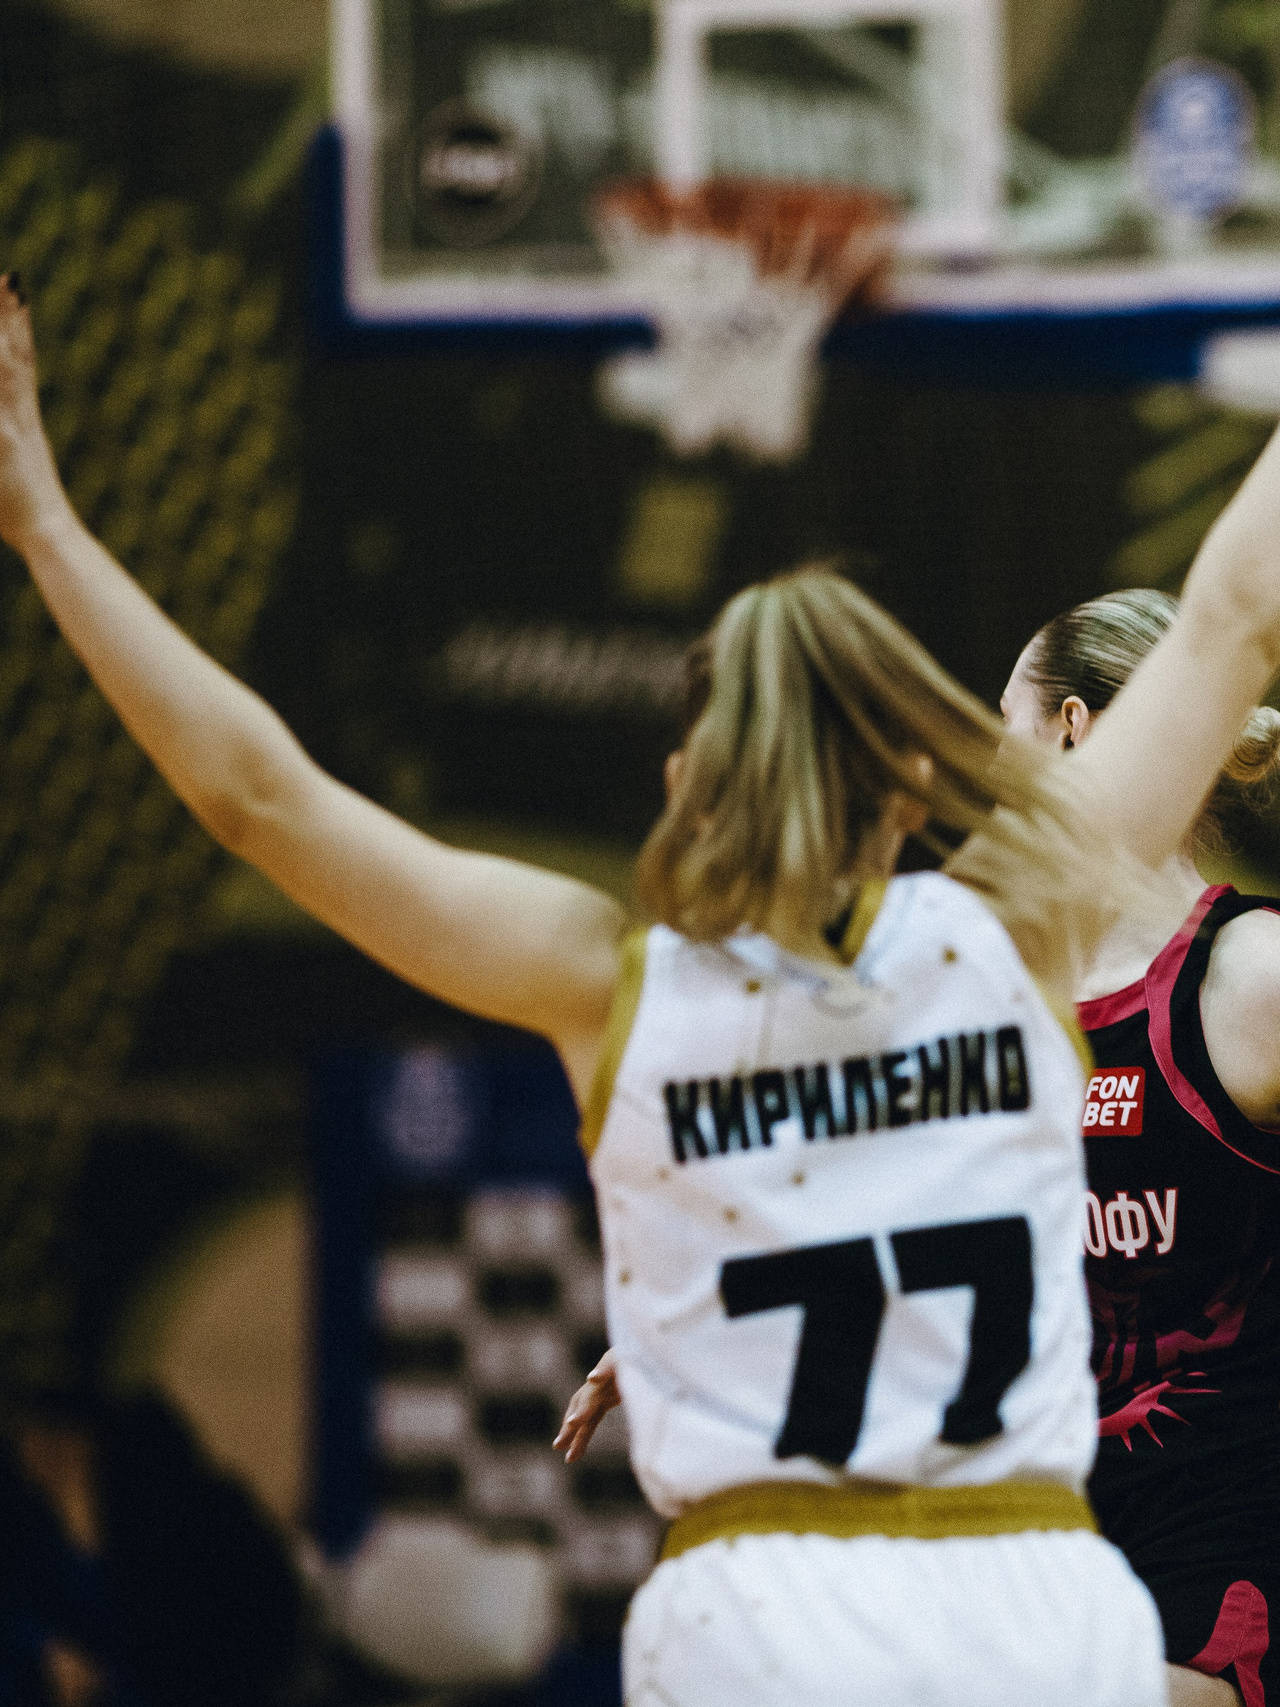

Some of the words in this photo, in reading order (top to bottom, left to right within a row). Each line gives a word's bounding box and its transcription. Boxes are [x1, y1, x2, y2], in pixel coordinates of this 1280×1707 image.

[664, 1025, 1031, 1164] КИРИЛЕНКО
[1082, 1101, 1138, 1127] BET
[1085, 1074, 1140, 1100] FON
[718, 1214, 1036, 1466] 77
